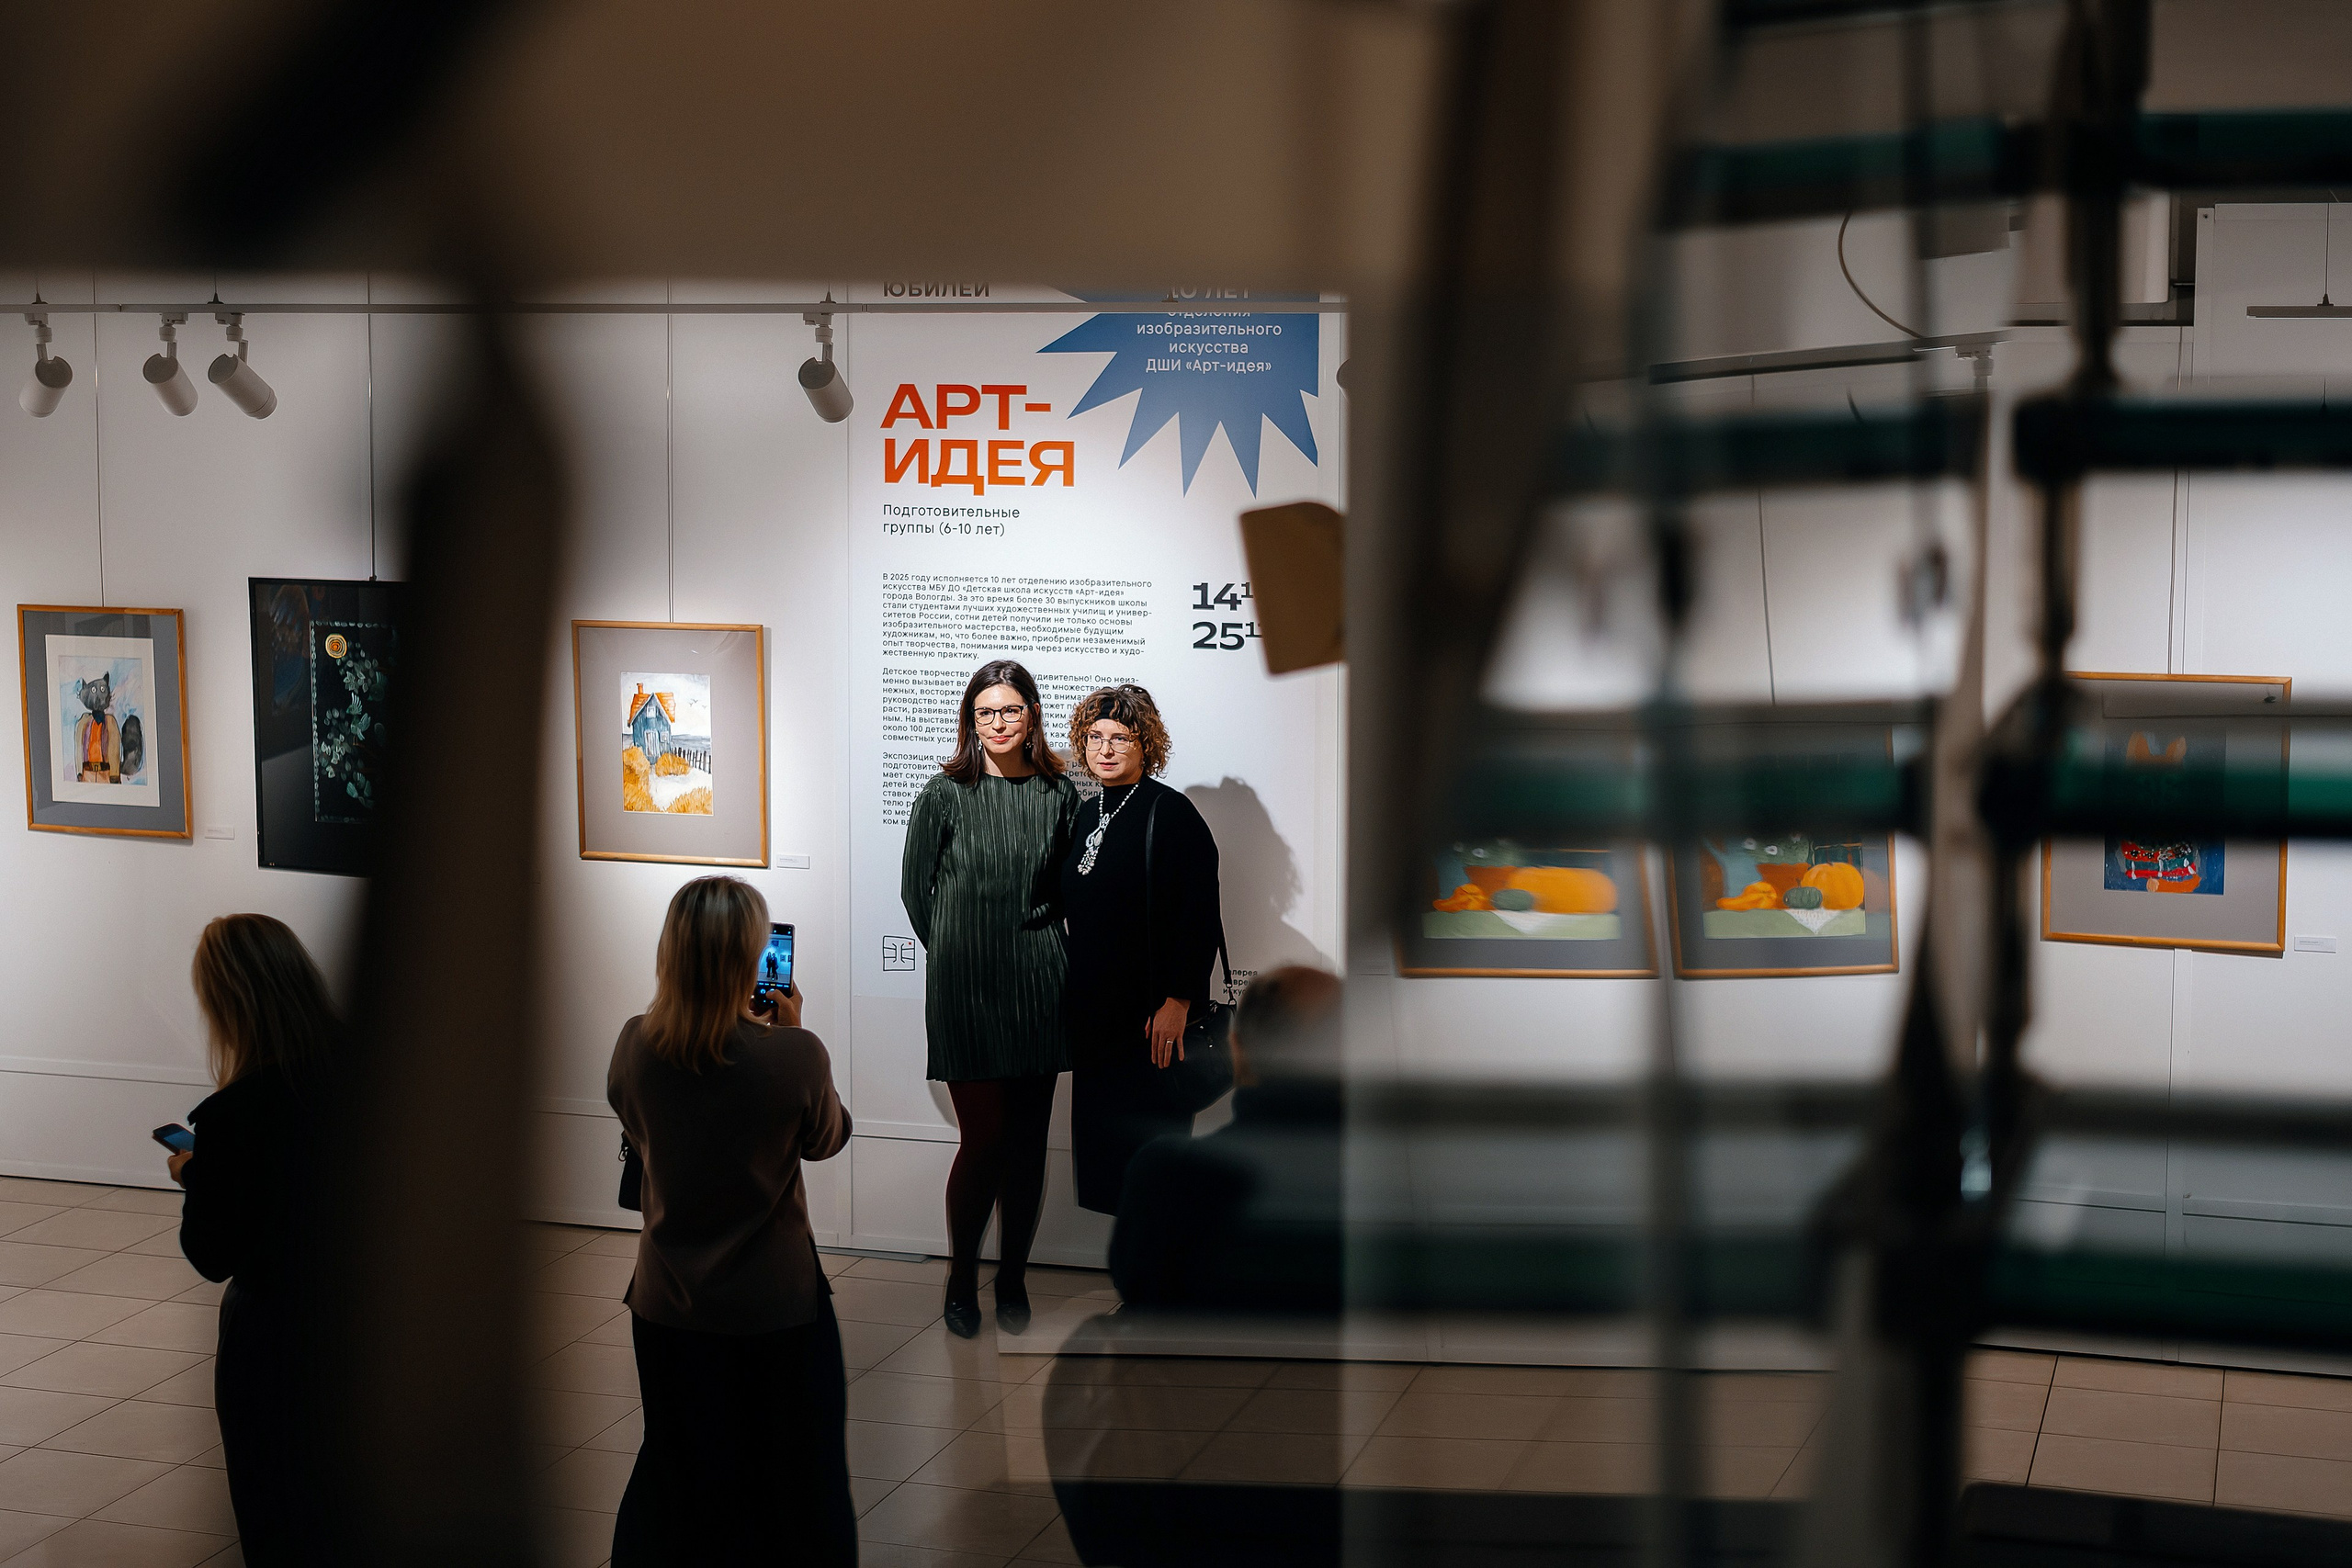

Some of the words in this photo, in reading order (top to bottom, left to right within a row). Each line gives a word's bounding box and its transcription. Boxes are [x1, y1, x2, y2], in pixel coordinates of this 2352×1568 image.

[1136, 322, 1283, 337] изобразительного
[1169, 343, 1249, 356] искусства
[1146, 358, 1182, 373] ДШИ
[1185, 359, 1272, 374] «Арт-идея»
[880, 384, 1051, 430] АРТ-
[885, 438, 1074, 496] ИДЕЯ
[883, 504, 1021, 518] Подготовительные
[883, 523, 934, 536] группы
[939, 522, 971, 536] (6-10
[976, 523, 1005, 536] лет)
[882, 572, 888, 581] В
[890, 572, 910, 581] 2025
[911, 575, 931, 583] году
[933, 575, 989, 583] исполняется
[991, 575, 1000, 583] 10
[1069, 578, 1152, 588] изобразительного
[882, 583, 926, 592] искусства
[929, 583, 945, 592] МБУ
[948, 583, 960, 592] ДО
[963, 584, 1001, 593] «Детская
[1034, 588, 1073, 596] искусств
[1076, 587, 1125, 597] «Арт-идея»
[882, 593, 913, 602] города
[915, 592, 956, 602] Вологды.
[957, 593, 967, 602] За
[987, 596, 1014, 604] время
[1016, 595, 1043, 604] более
[1046, 596, 1055, 604] 30
[1057, 598, 1115, 606] выпускников
[910, 604, 960, 612] студентами
[963, 604, 994, 613] лучших
[997, 605, 1070, 615] художественных
[1072, 608, 1106, 616] училищ
[1116, 609, 1152, 618] универ-
[919, 611, 952, 622] России,
[982, 614, 1007, 622] детей
[1010, 615, 1051, 624] получили
[882, 620, 963, 629] изобразительного
[965, 624, 1018, 633] мастерства,
[1021, 625, 1081, 634] необходимые
[1083, 626, 1124, 636] будущим
[882, 630, 938, 640] художникам,
[940, 632, 953, 640] но,
[971, 632, 998, 640] более
[1001, 634, 1030, 643] важно,
[1032, 634, 1080, 644] приобрели
[1083, 637, 1145, 645] незаменимый
[882, 649, 935, 659] жественную
[937, 651, 979, 660] практику.
[906, 640, 957, 650] творчества,
[961, 642, 1009, 650] понимания
[1012, 644, 1033, 652] мира
[1036, 645, 1062, 653] через
[1064, 646, 1109, 655] искусство
[1120, 648, 1144, 656] худо-
[882, 668, 917, 676] Детское
[920, 671, 970, 679] творчество
[882, 687, 918, 696] нежных,
[882, 697, 937, 705] руководство
[882, 706, 910, 715] расти,
[905, 715, 916, 723] На
[910, 724, 922, 732] 100
[882, 734, 934, 742] совместных
[882, 751, 933, 761] Экспозиция
[882, 781, 908, 789] детей
